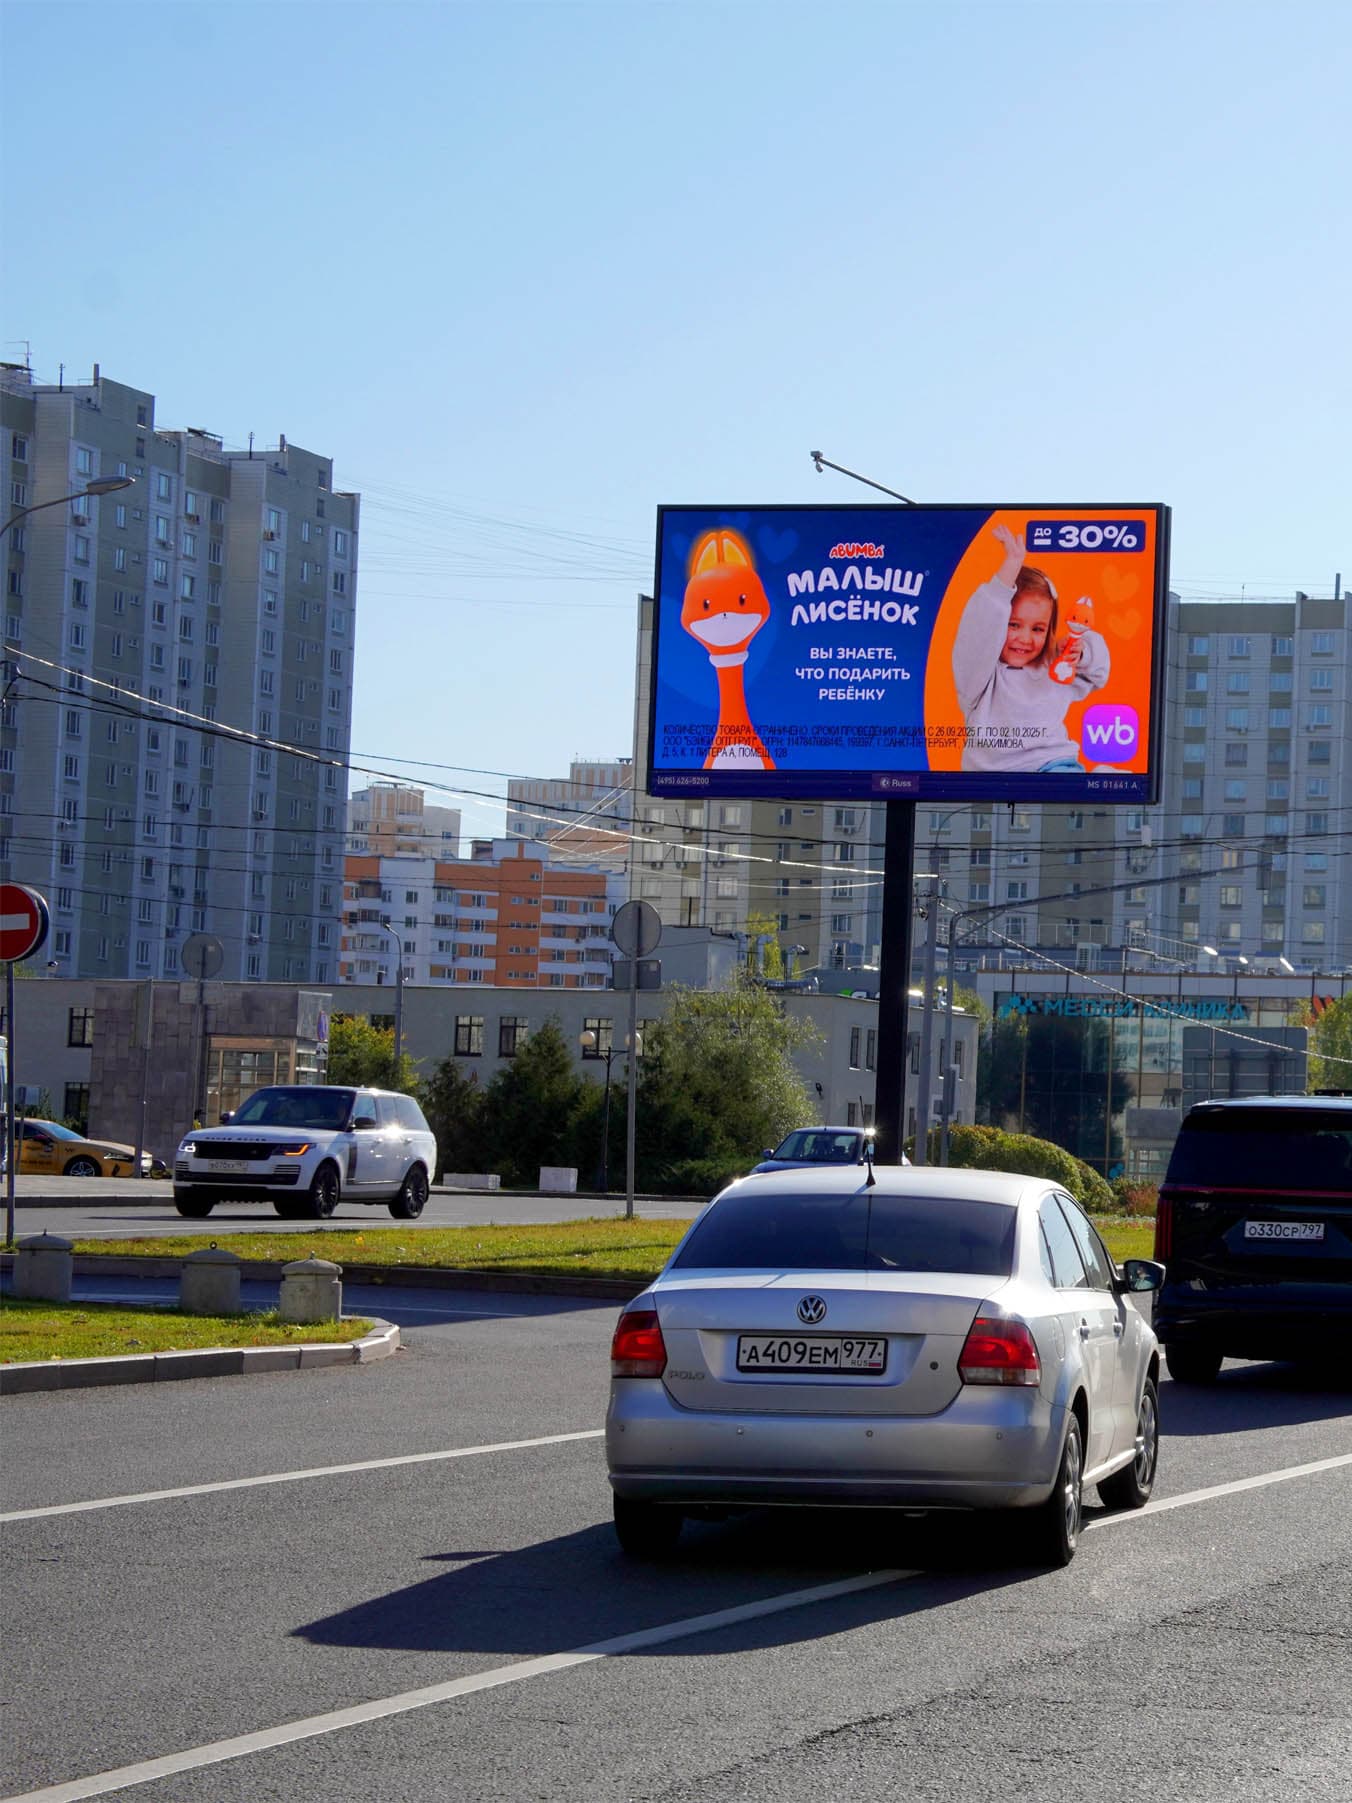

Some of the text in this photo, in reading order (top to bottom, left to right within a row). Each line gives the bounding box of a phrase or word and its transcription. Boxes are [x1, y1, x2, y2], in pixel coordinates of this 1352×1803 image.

[787, 565, 924, 597] МАЛЫШ
[791, 595, 919, 626] ЛИСЁНОК
[810, 647, 897, 661] ВЫ ЗНАЕТЕ,
[795, 667, 911, 682] ЧТО ПОДАРИТЬ
[819, 685, 885, 701] РЕБЁНКУ
[719, 725, 751, 735] ТОВАРА
[927, 727, 934, 737] С
[986, 727, 999, 737] ПО
[1000, 727, 1041, 738] 02.10.2025
[1086, 716, 1135, 746] wb
[664, 736, 681, 745] ООО
[892, 778, 912, 787] Russ
[1087, 781, 1100, 789] MS
